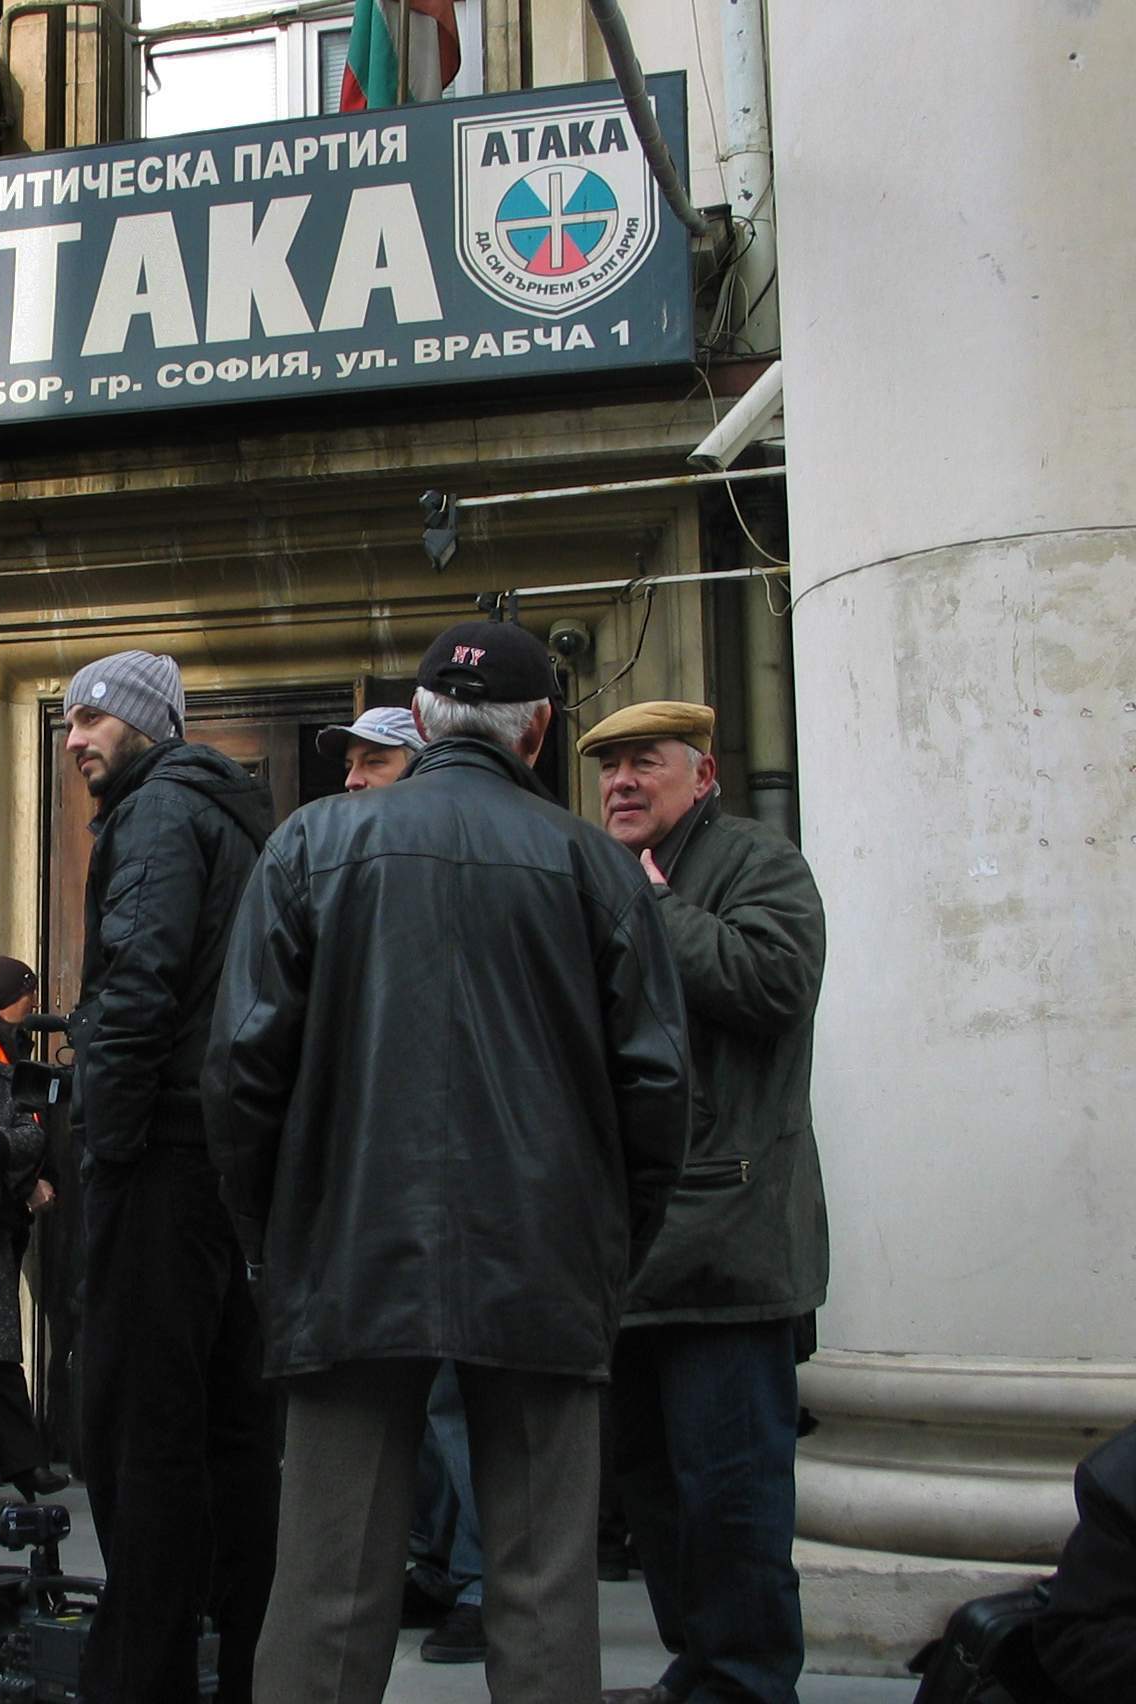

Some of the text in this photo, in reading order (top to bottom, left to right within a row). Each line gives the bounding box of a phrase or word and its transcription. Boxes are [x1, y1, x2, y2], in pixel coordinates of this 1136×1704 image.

[234, 124, 408, 182] ПАРТИЯ
[481, 118, 630, 167] АТАКА
[475, 231, 492, 254] ДА
[486, 254, 505, 275] СИ
[502, 271, 574, 296] ВЪРНЕМ
[90, 375, 142, 400] гр.
[157, 349, 322, 388] СОФИЯ,
[336, 348, 398, 379] ул.
[414, 324, 595, 364] ВРАБЧА
[610, 320, 631, 347] 1
[451, 645, 486, 666] NY
